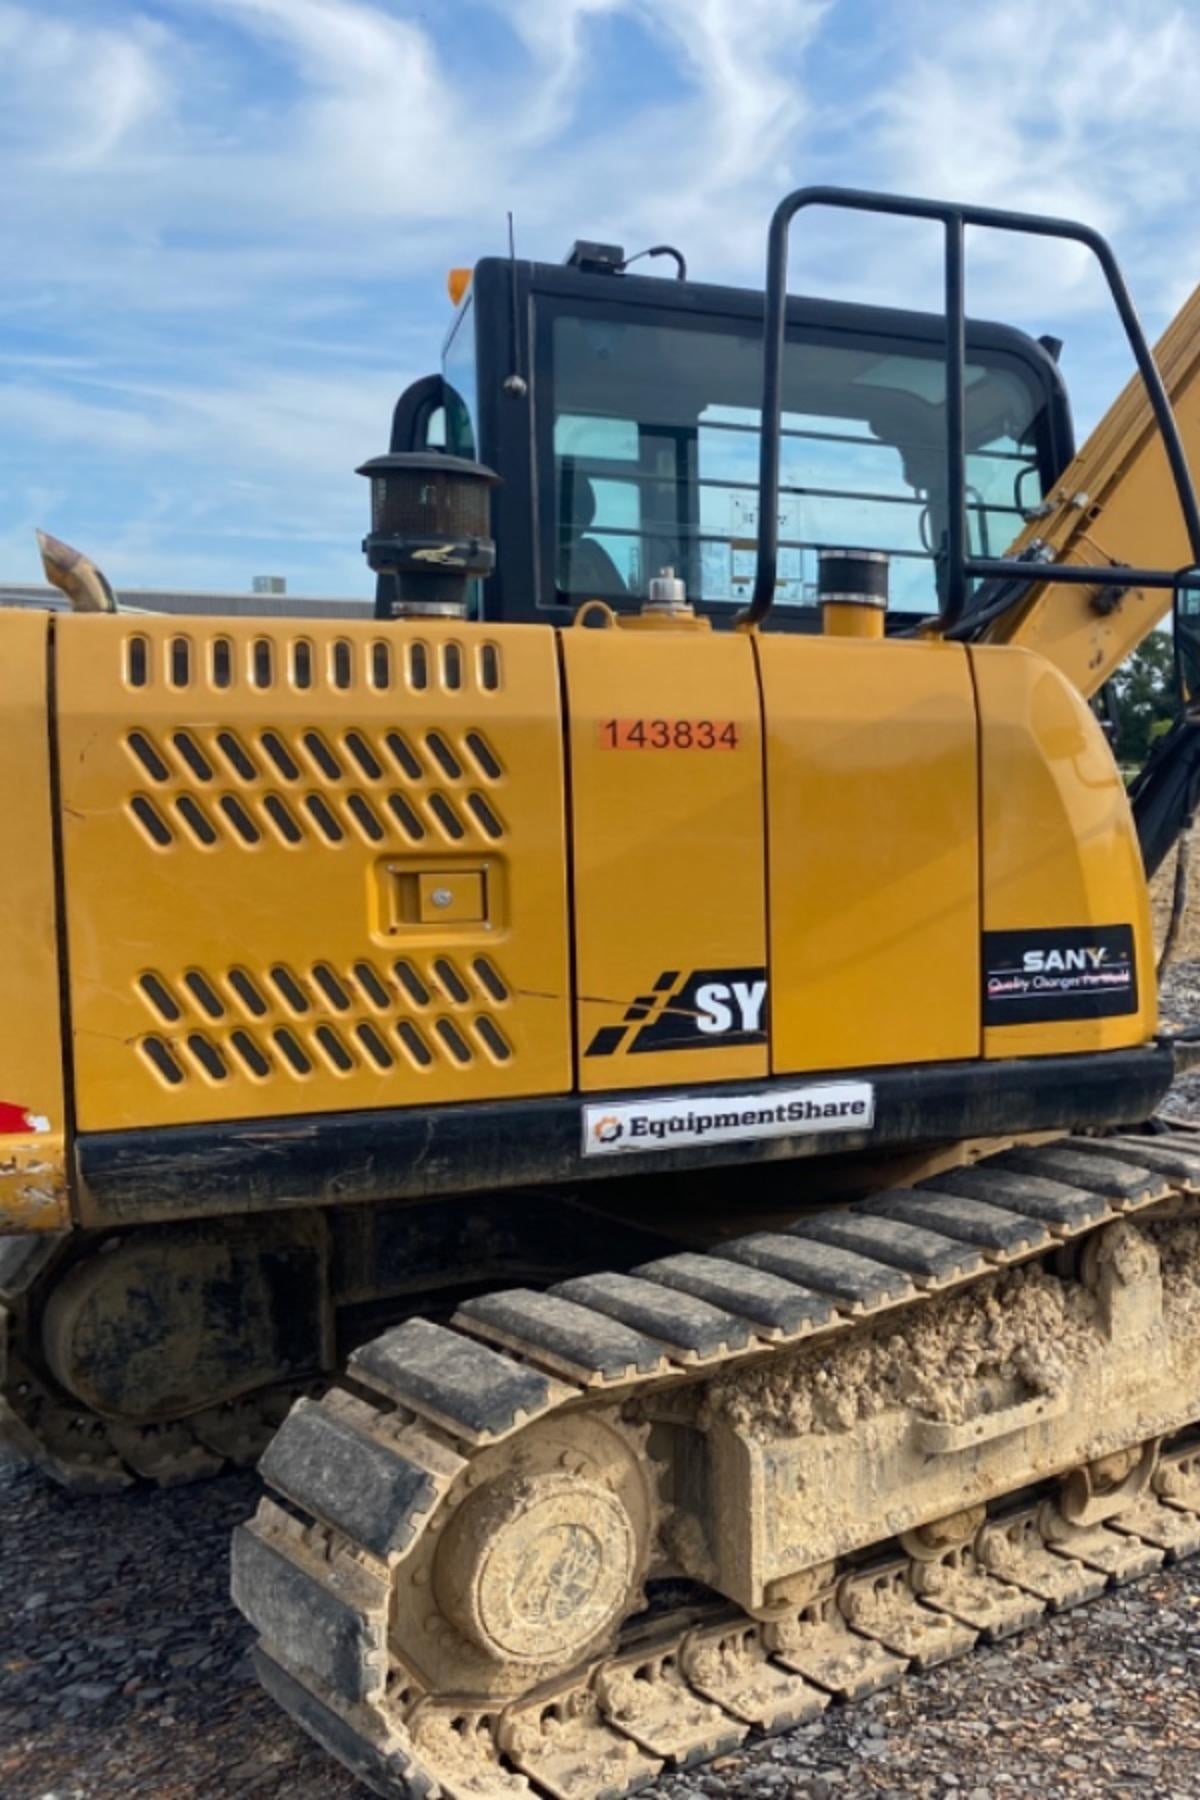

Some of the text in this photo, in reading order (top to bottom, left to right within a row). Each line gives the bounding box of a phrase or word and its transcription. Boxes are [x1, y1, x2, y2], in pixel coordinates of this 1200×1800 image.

[605, 719, 739, 749] 143834
[1023, 947, 1107, 972] SANY
[695, 981, 767, 1034] SY
[629, 1099, 866, 1139] EquipmentShare
